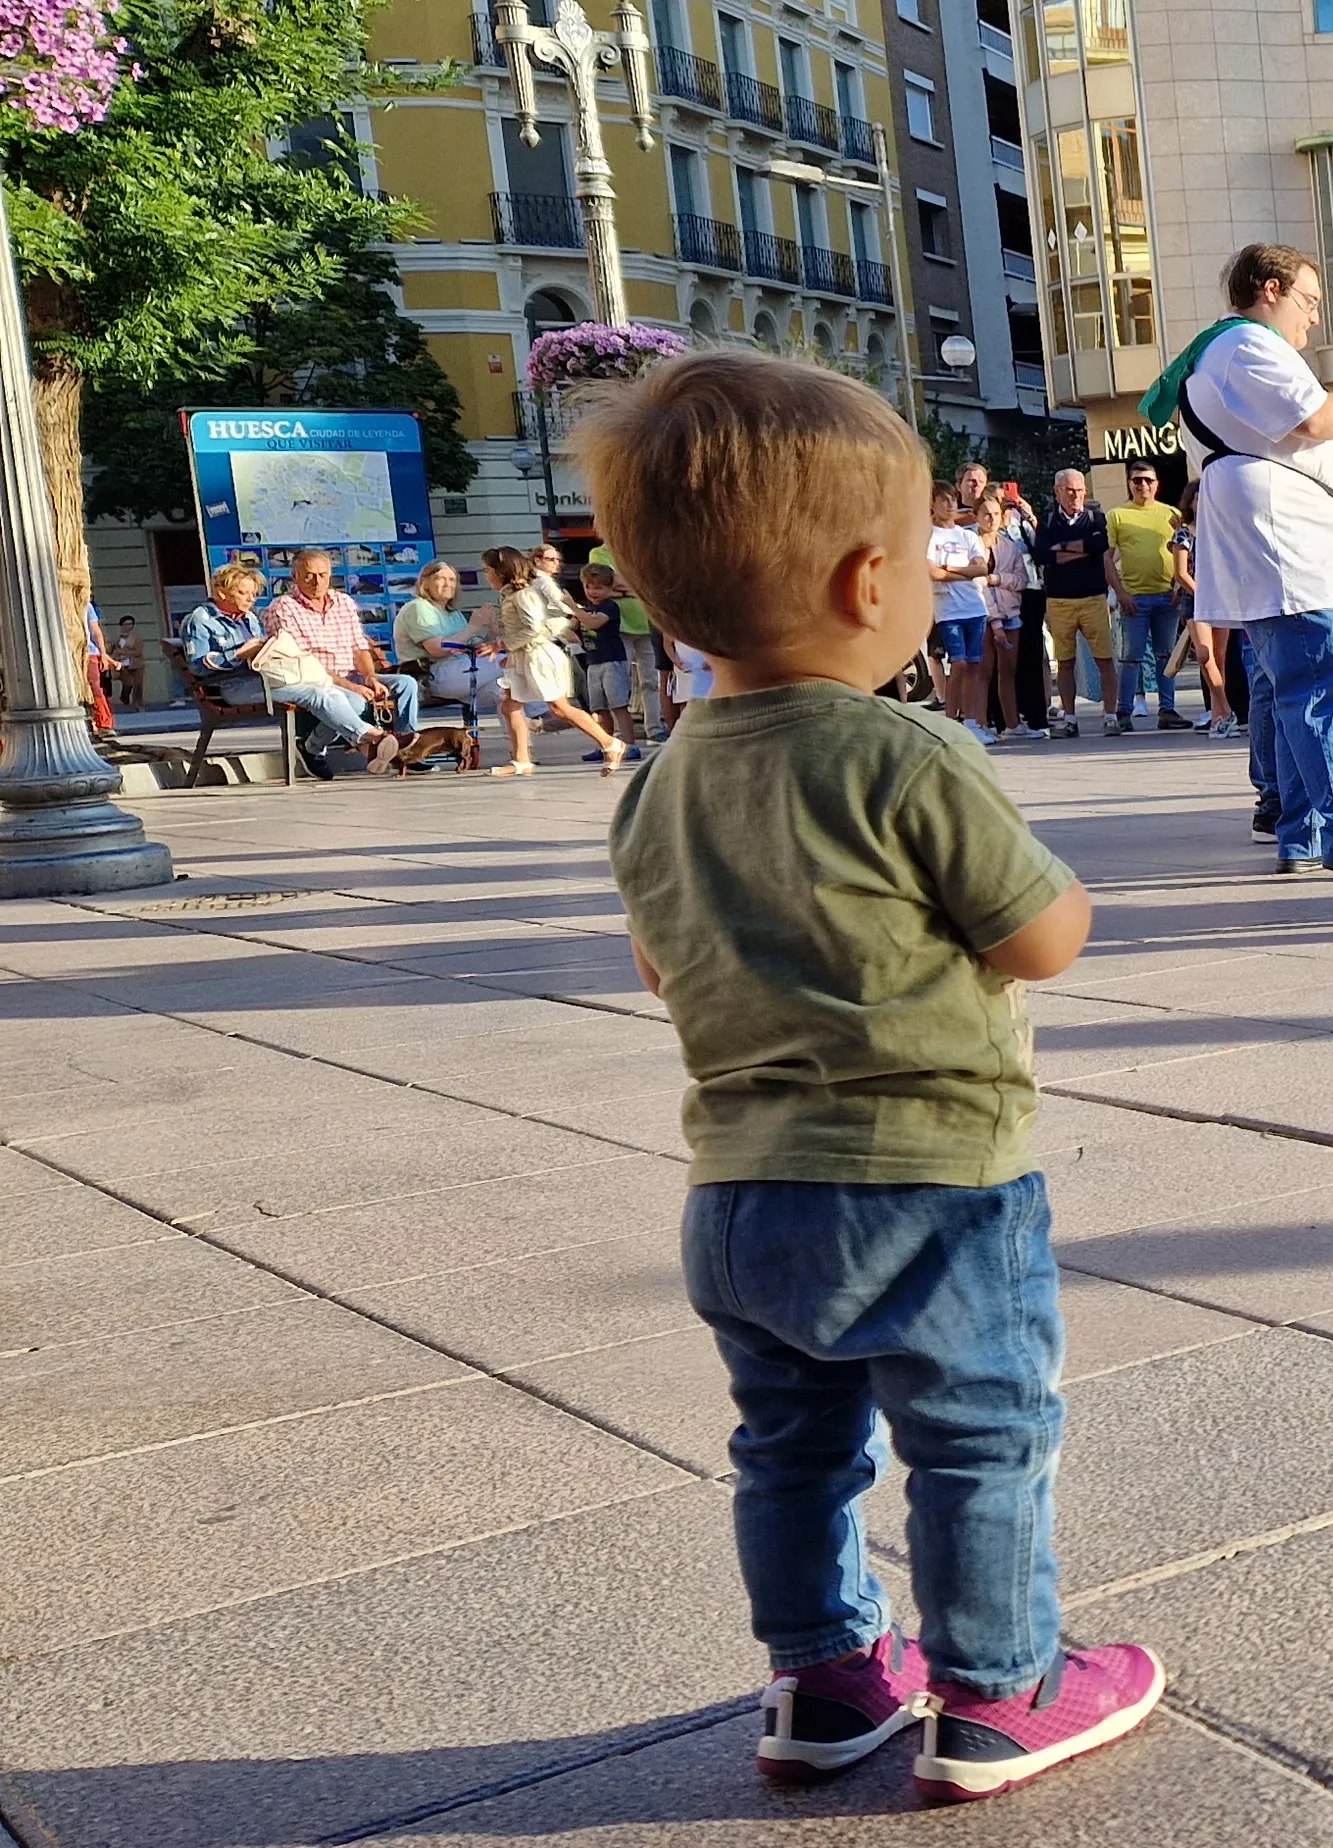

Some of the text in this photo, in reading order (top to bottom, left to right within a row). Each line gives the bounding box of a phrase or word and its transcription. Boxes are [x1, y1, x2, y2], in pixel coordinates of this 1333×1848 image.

[207, 420, 405, 439] HUESCA CIUDAD DE LEYENDA
[298, 438, 353, 449] VISITAR
